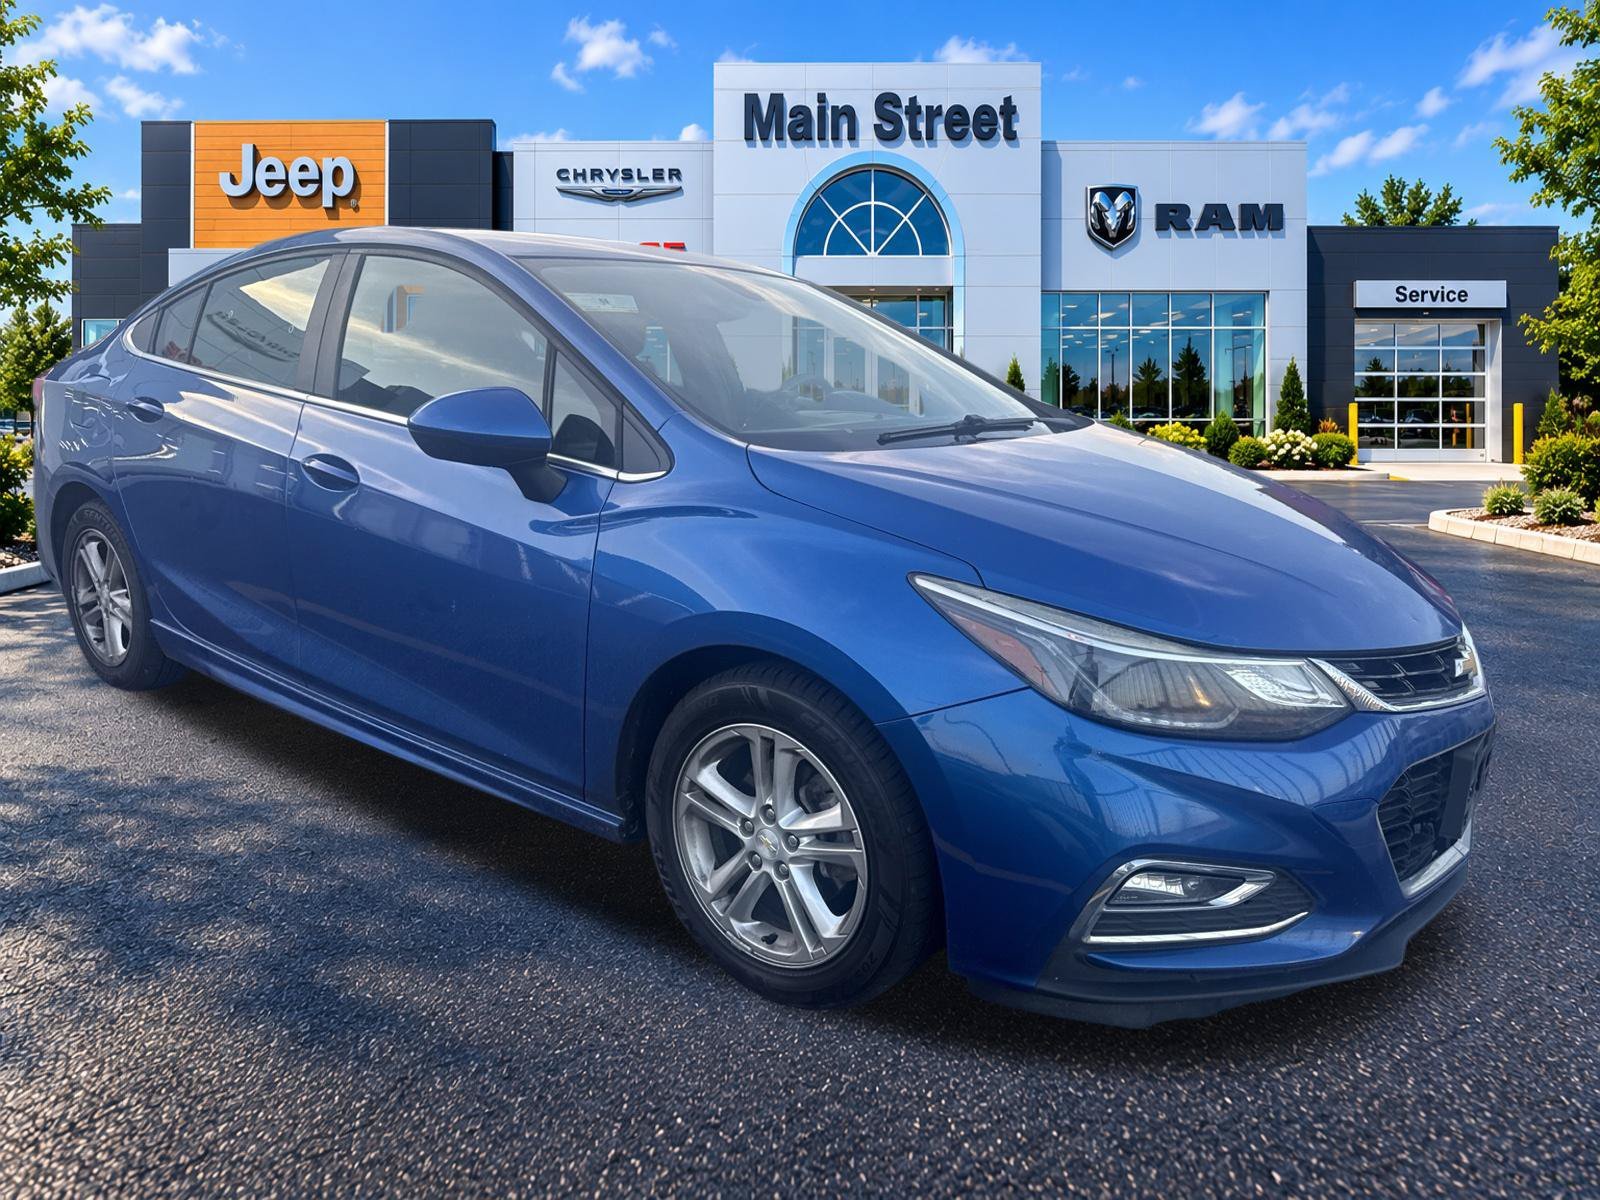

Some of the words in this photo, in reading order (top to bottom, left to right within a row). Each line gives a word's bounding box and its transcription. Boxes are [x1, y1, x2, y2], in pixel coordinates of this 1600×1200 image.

[744, 93, 857, 141] Main
[873, 91, 1017, 142] Street
[218, 143, 356, 209] Jeep
[556, 167, 683, 182] CHRYSLER
[1154, 203, 1284, 232] RAM
[1395, 285, 1469, 303] Service
